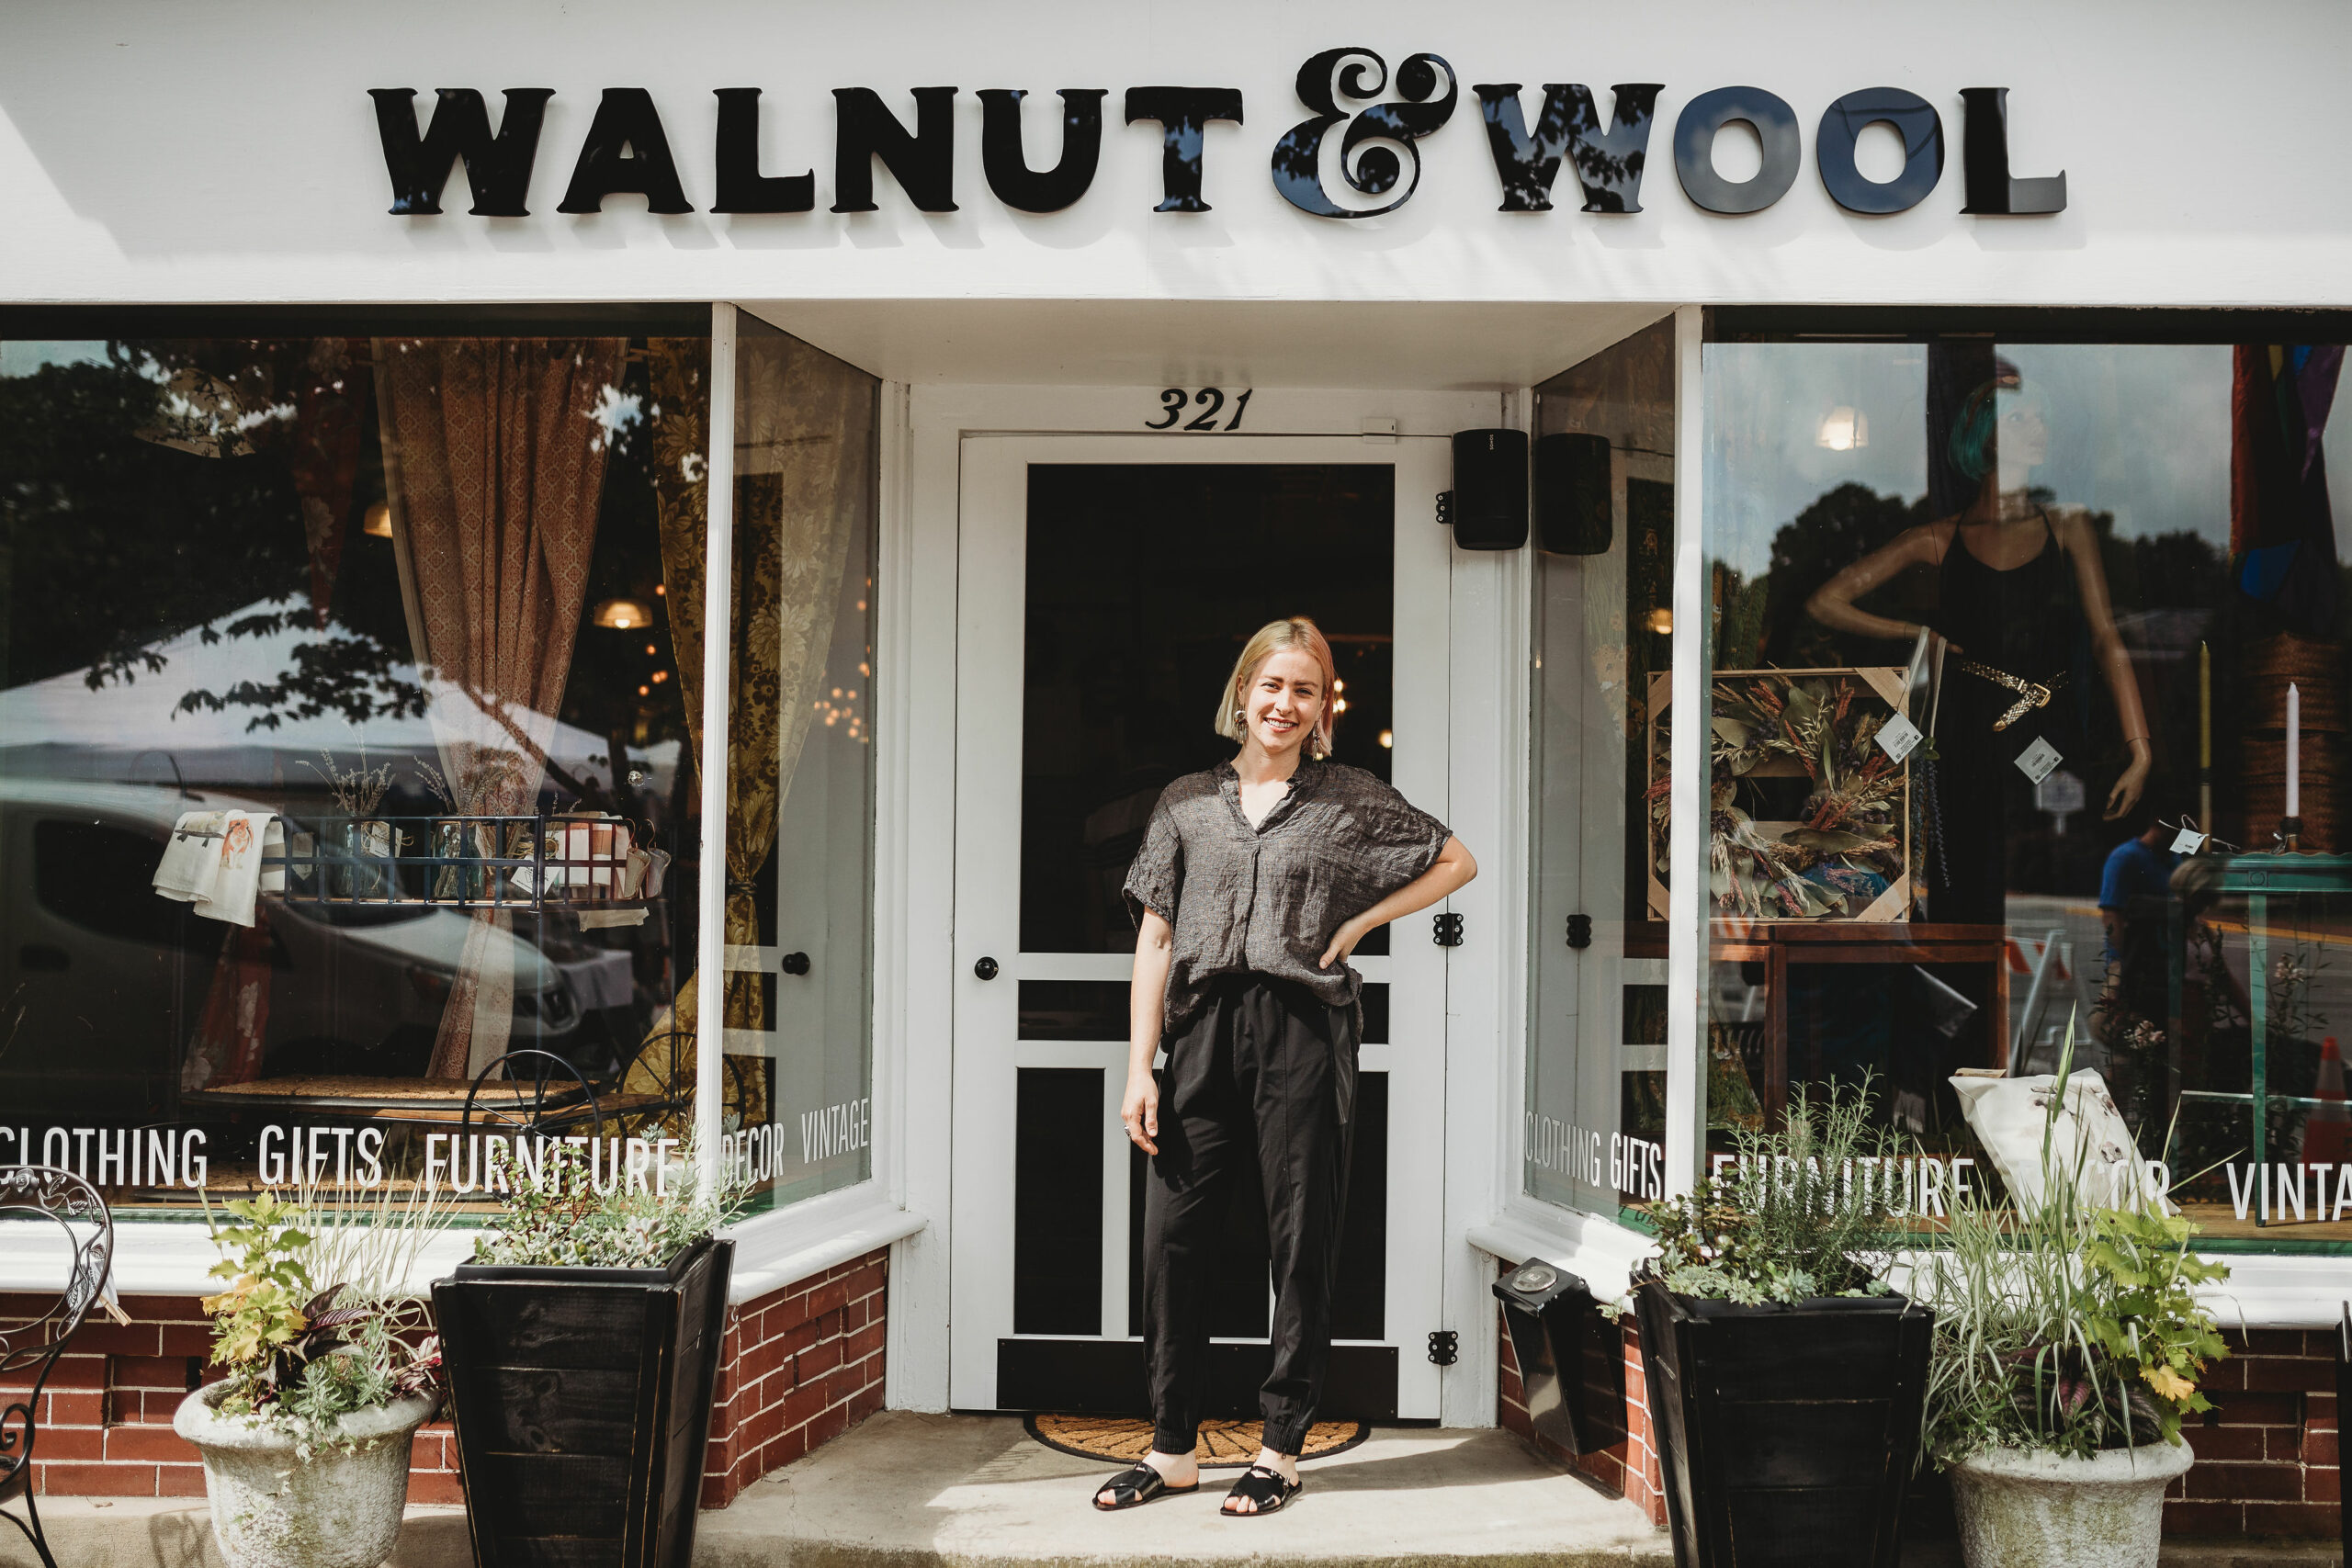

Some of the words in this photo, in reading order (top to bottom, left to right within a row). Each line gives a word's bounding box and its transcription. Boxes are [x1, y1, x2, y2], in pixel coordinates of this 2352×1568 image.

[367, 86, 1243, 217] WALNUT
[1271, 46, 1458, 220] &
[1472, 83, 2067, 215] WOOL
[1145, 387, 1253, 431] 321
[258, 1123, 383, 1188] GIFTS
[425, 1133, 680, 1199] FURNITURE
[721, 1122, 786, 1190] DECOR
[801, 1097, 869, 1164] VINTAGE
[1525, 1110, 1601, 1188] CLOTHING
[1610, 1131, 1662, 1202] GIFTS
[2020, 1158, 2171, 1220] COR
